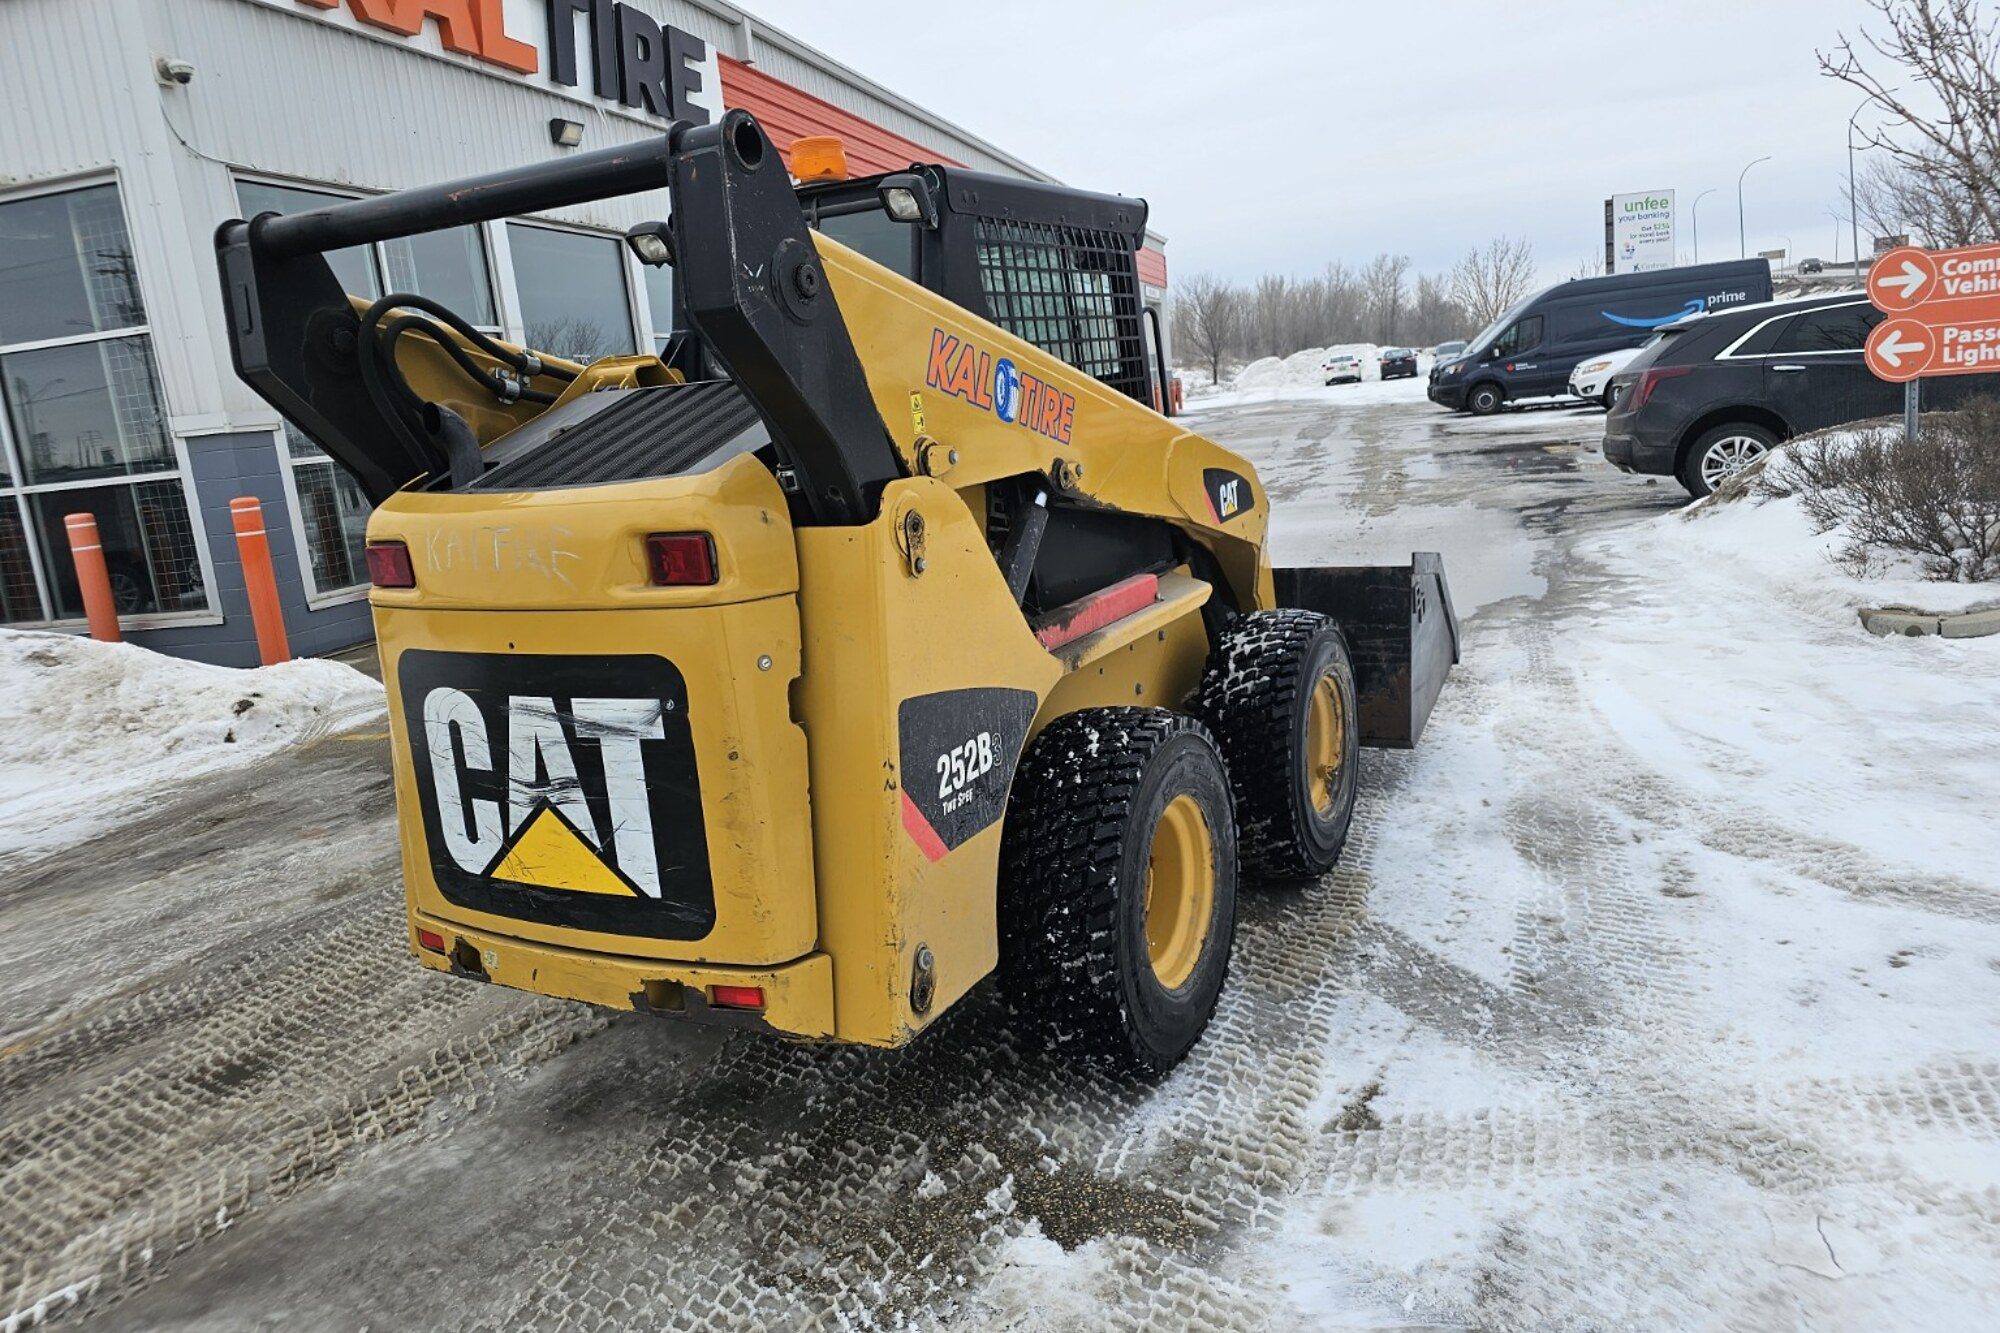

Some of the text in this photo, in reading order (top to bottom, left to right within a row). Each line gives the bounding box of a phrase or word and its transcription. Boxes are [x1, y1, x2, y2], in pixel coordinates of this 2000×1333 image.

[548, 0, 709, 124] TIRE
[1624, 197, 1669, 212] unfee
[1618, 211, 1670, 223] your banking
[1943, 259, 2000, 276] Com
[1943, 273, 2000, 295] Vehi
[1708, 291, 1746, 307] prime
[926, 328, 1075, 446] KAL TIRE
[1219, 479, 1239, 517] CAT
[423, 686, 665, 899] CAT
